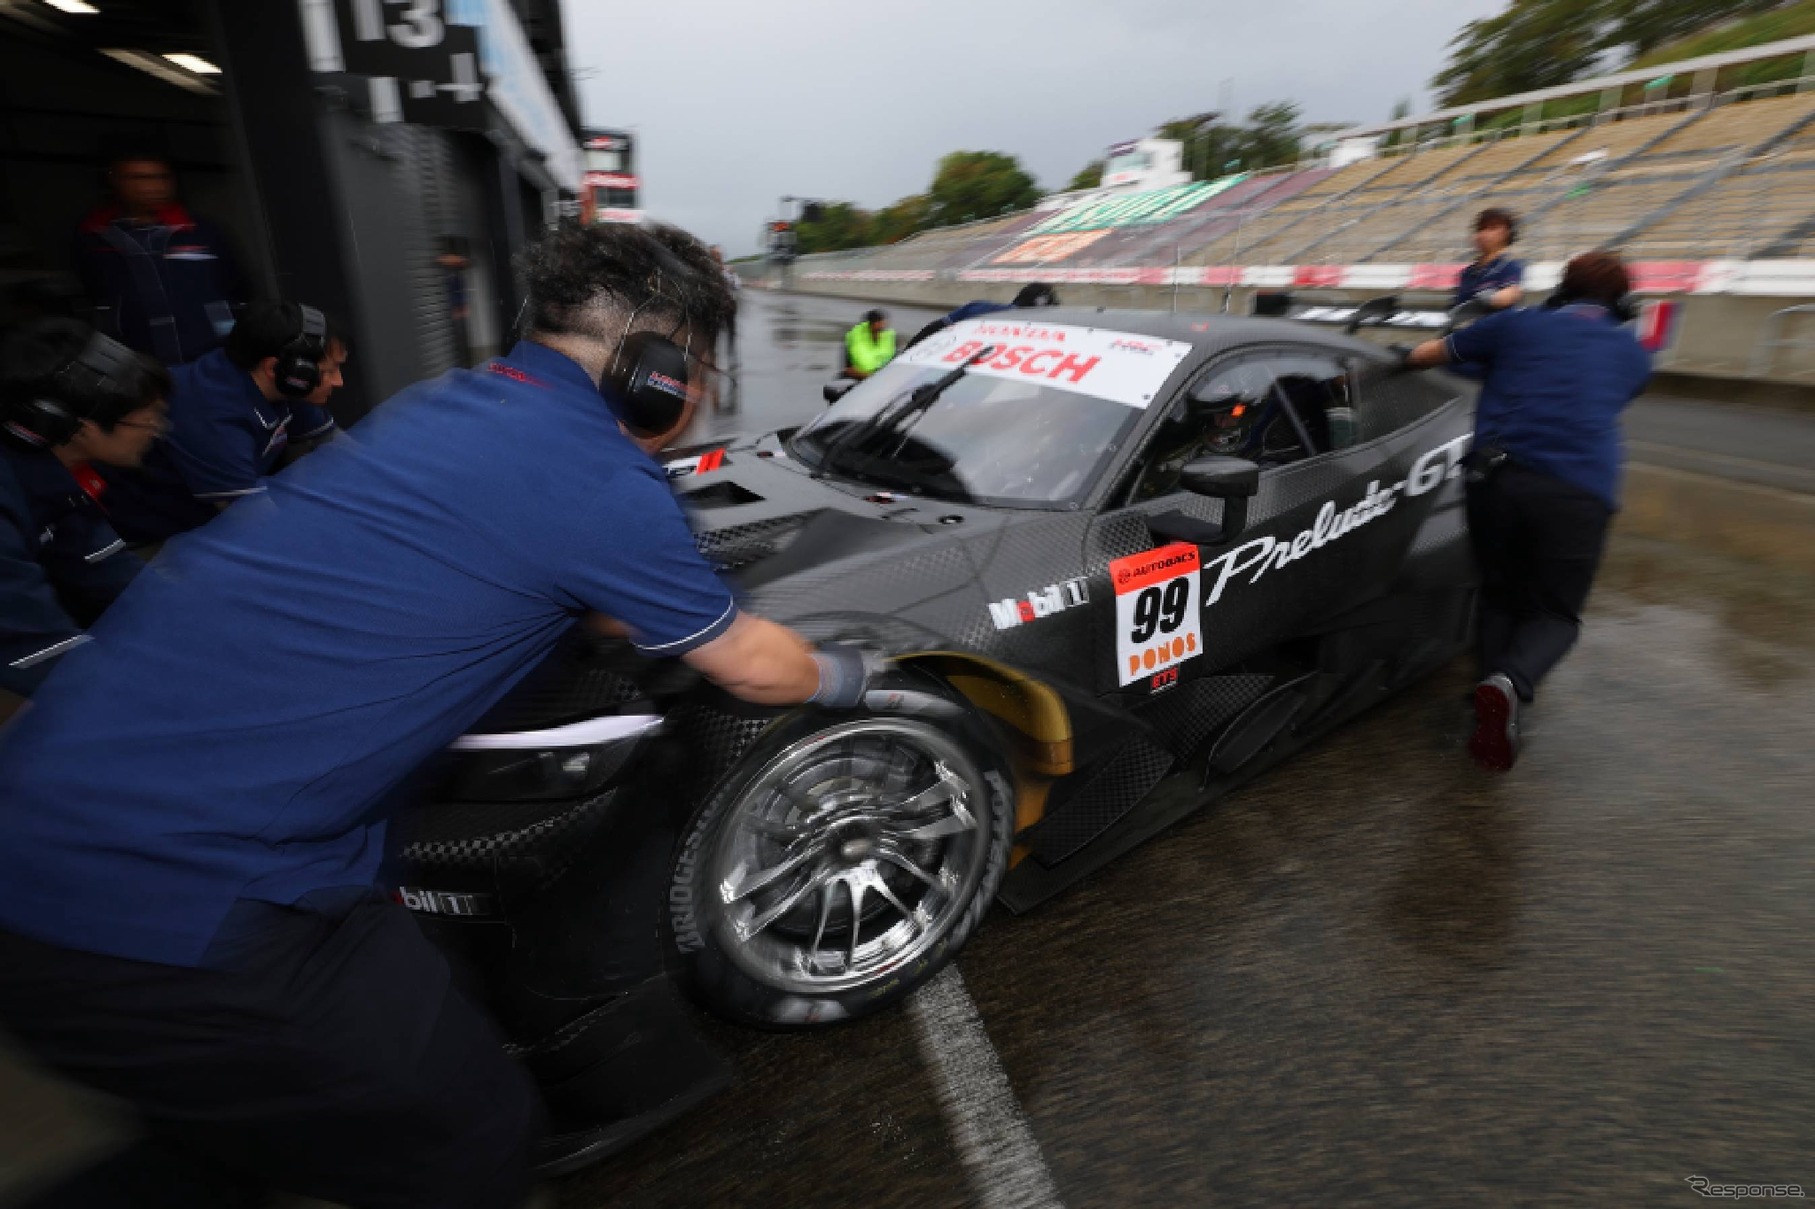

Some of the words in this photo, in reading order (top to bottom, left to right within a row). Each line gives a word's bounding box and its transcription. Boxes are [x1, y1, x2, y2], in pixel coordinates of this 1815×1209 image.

[941, 340, 1101, 383] BOSCH
[1133, 551, 1196, 578] AUTOBACS
[987, 584, 1066, 630] Mobil
[1131, 576, 1190, 644] 99
[1129, 632, 1197, 676] PONOS
